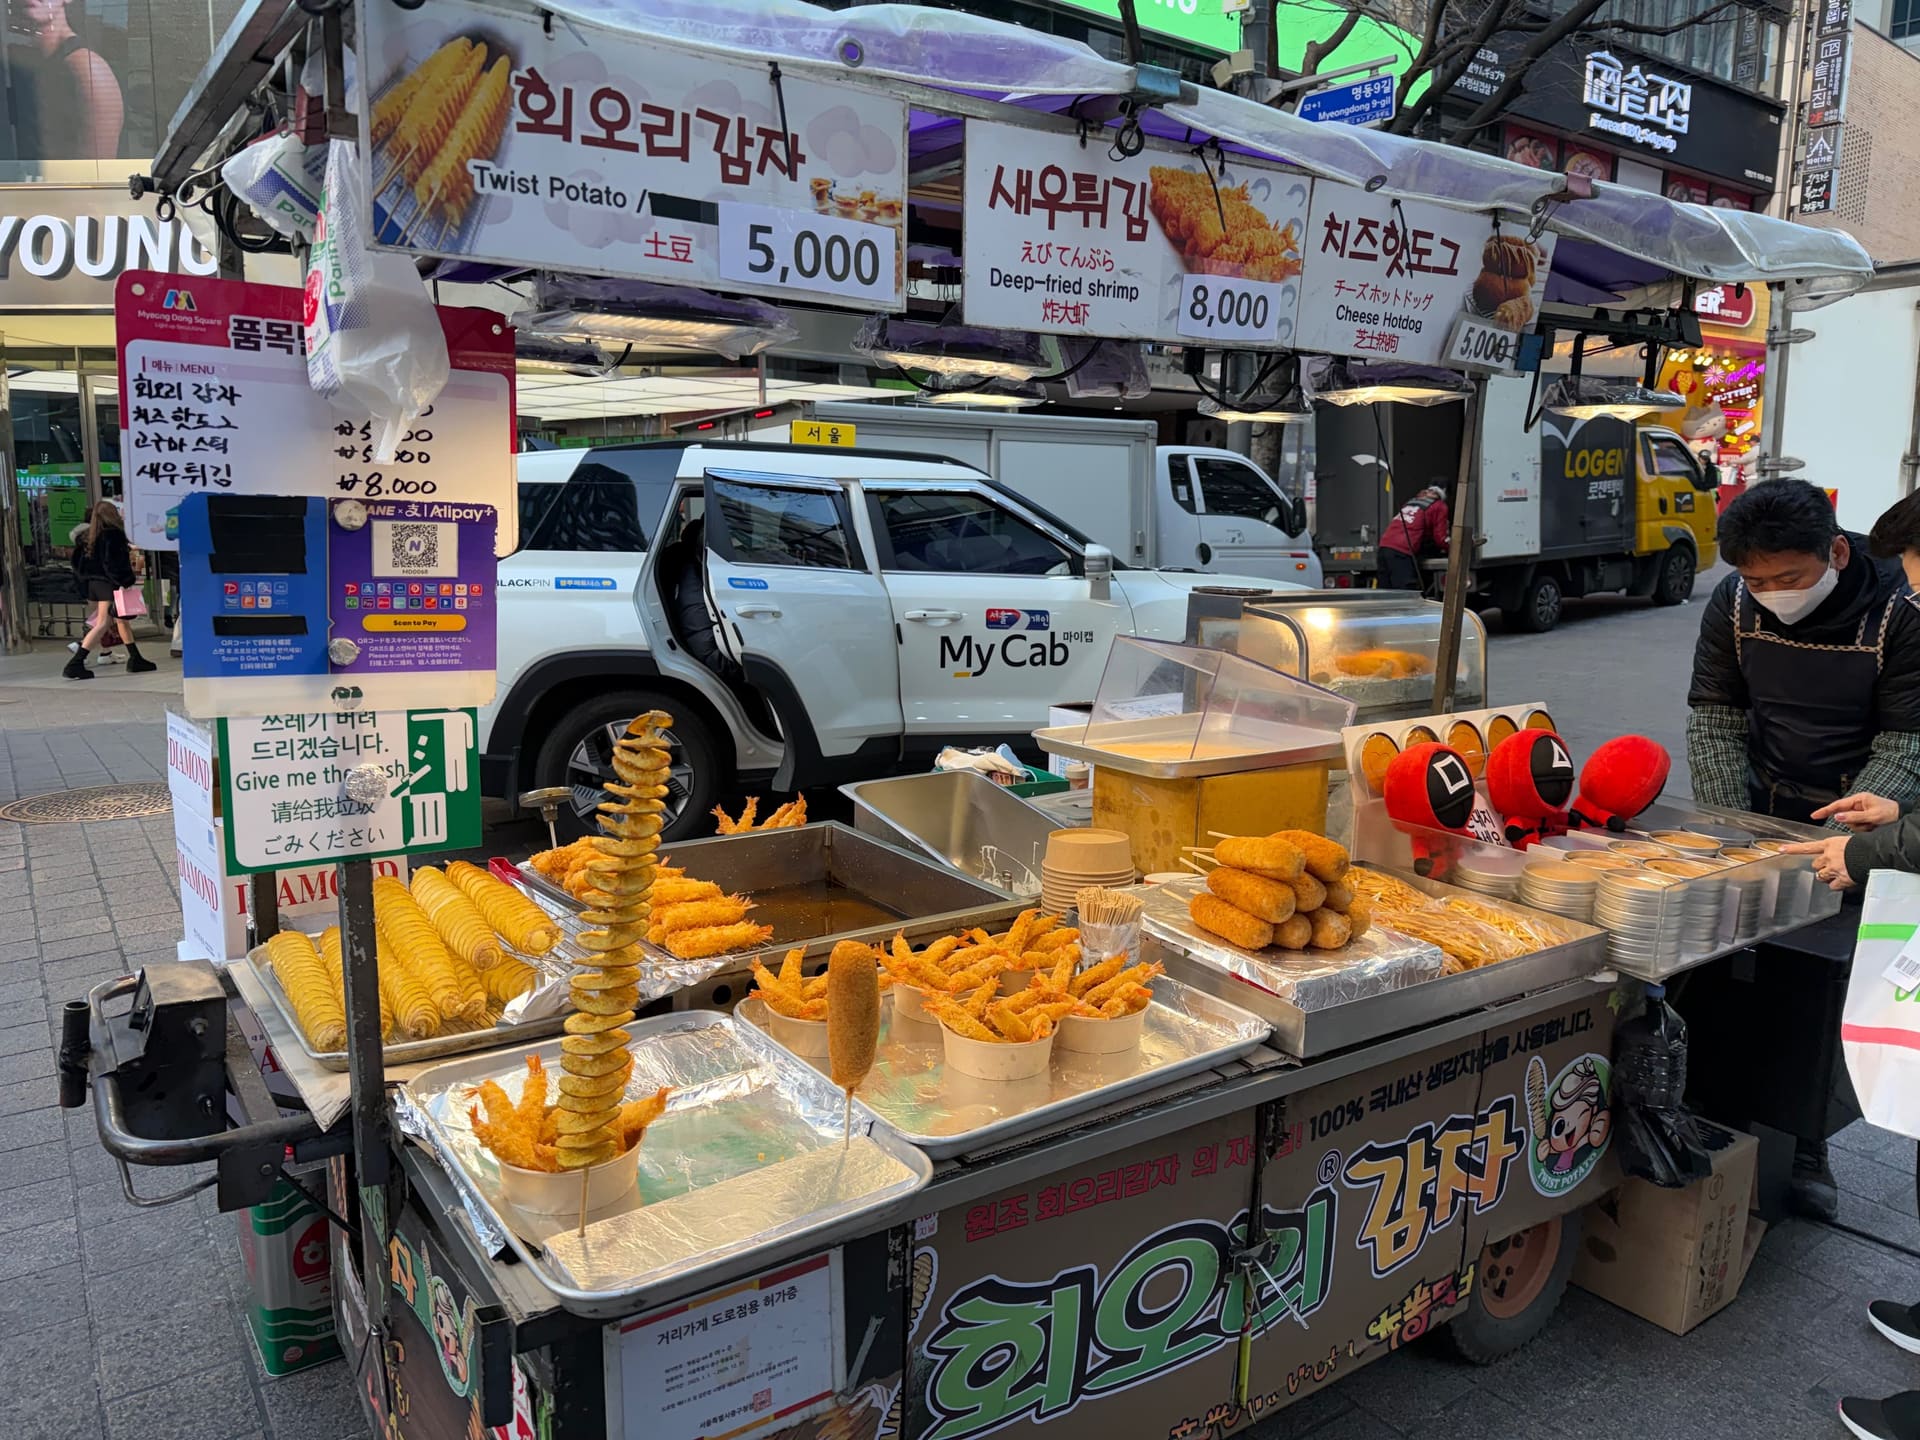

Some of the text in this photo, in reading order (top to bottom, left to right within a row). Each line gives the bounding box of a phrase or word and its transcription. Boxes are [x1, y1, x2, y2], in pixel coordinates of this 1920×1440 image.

[1351, 78, 1392, 101] 명동9길
[513, 67, 806, 185] 회오리감자
[1318, 103, 1370, 121] Myeongdong
[474, 165, 627, 208] Twist Potato
[988, 164, 1149, 242] 새우튀김
[644, 231, 694, 264] 土豆
[748, 223, 881, 286] 5,000
[1321, 211, 1460, 278] 치즈핫도그
[990, 267, 1139, 302] Deep-fried shrimp
[138, 310, 222, 327] Myeong Dong Square
[1042, 298, 1090, 326] 炸大虾
[1189, 284, 1269, 329] 8,000
[1336, 304, 1423, 334] Cheese Hotdog
[231, 318, 306, 356] 품목
[1353, 328, 1400, 353] 芝士热狗
[1460, 326, 1509, 363] 5,000
[152, 360, 215, 375] 메뉴 MENU
[133, 373, 183, 401] 회오리
[1712, 385, 1754, 402] BUTTER
[807, 427, 842, 444] 서울
[136, 462, 232, 488] 새우튀김
[430, 505, 494, 522] Alipay+
[393, 619, 437, 628] Scan to Pay
[1063, 631, 1093, 643] 마이캡
[262, 711, 377, 733] 쓰레기 버려
[251, 732, 389, 761] 드리겠습니다.
[169, 737, 210, 793] DIAMOND
[236, 771, 280, 792] Give
[287, 771, 316, 787] me
[271, 796, 376, 824] 请给我垃圾
[264, 827, 385, 856] ごみください
[177, 848, 218, 912] DIAMOND
[1309, 1096, 1364, 1141] 100%
[1369, 1070, 1423, 1113] 국내산
[1512, 1007, 1594, 1056] 사용합니다.
[965, 1194, 1030, 1243] 원조
[1035, 1153, 1180, 1222] 회오리감자
[1191, 1143, 1220, 1177] 의
[1343, 1098, 1522, 1275] 감자
[1538, 1168, 1560, 1189] TWIST
[657, 1285, 799, 1345] 거리가게 도로점용 허가증
